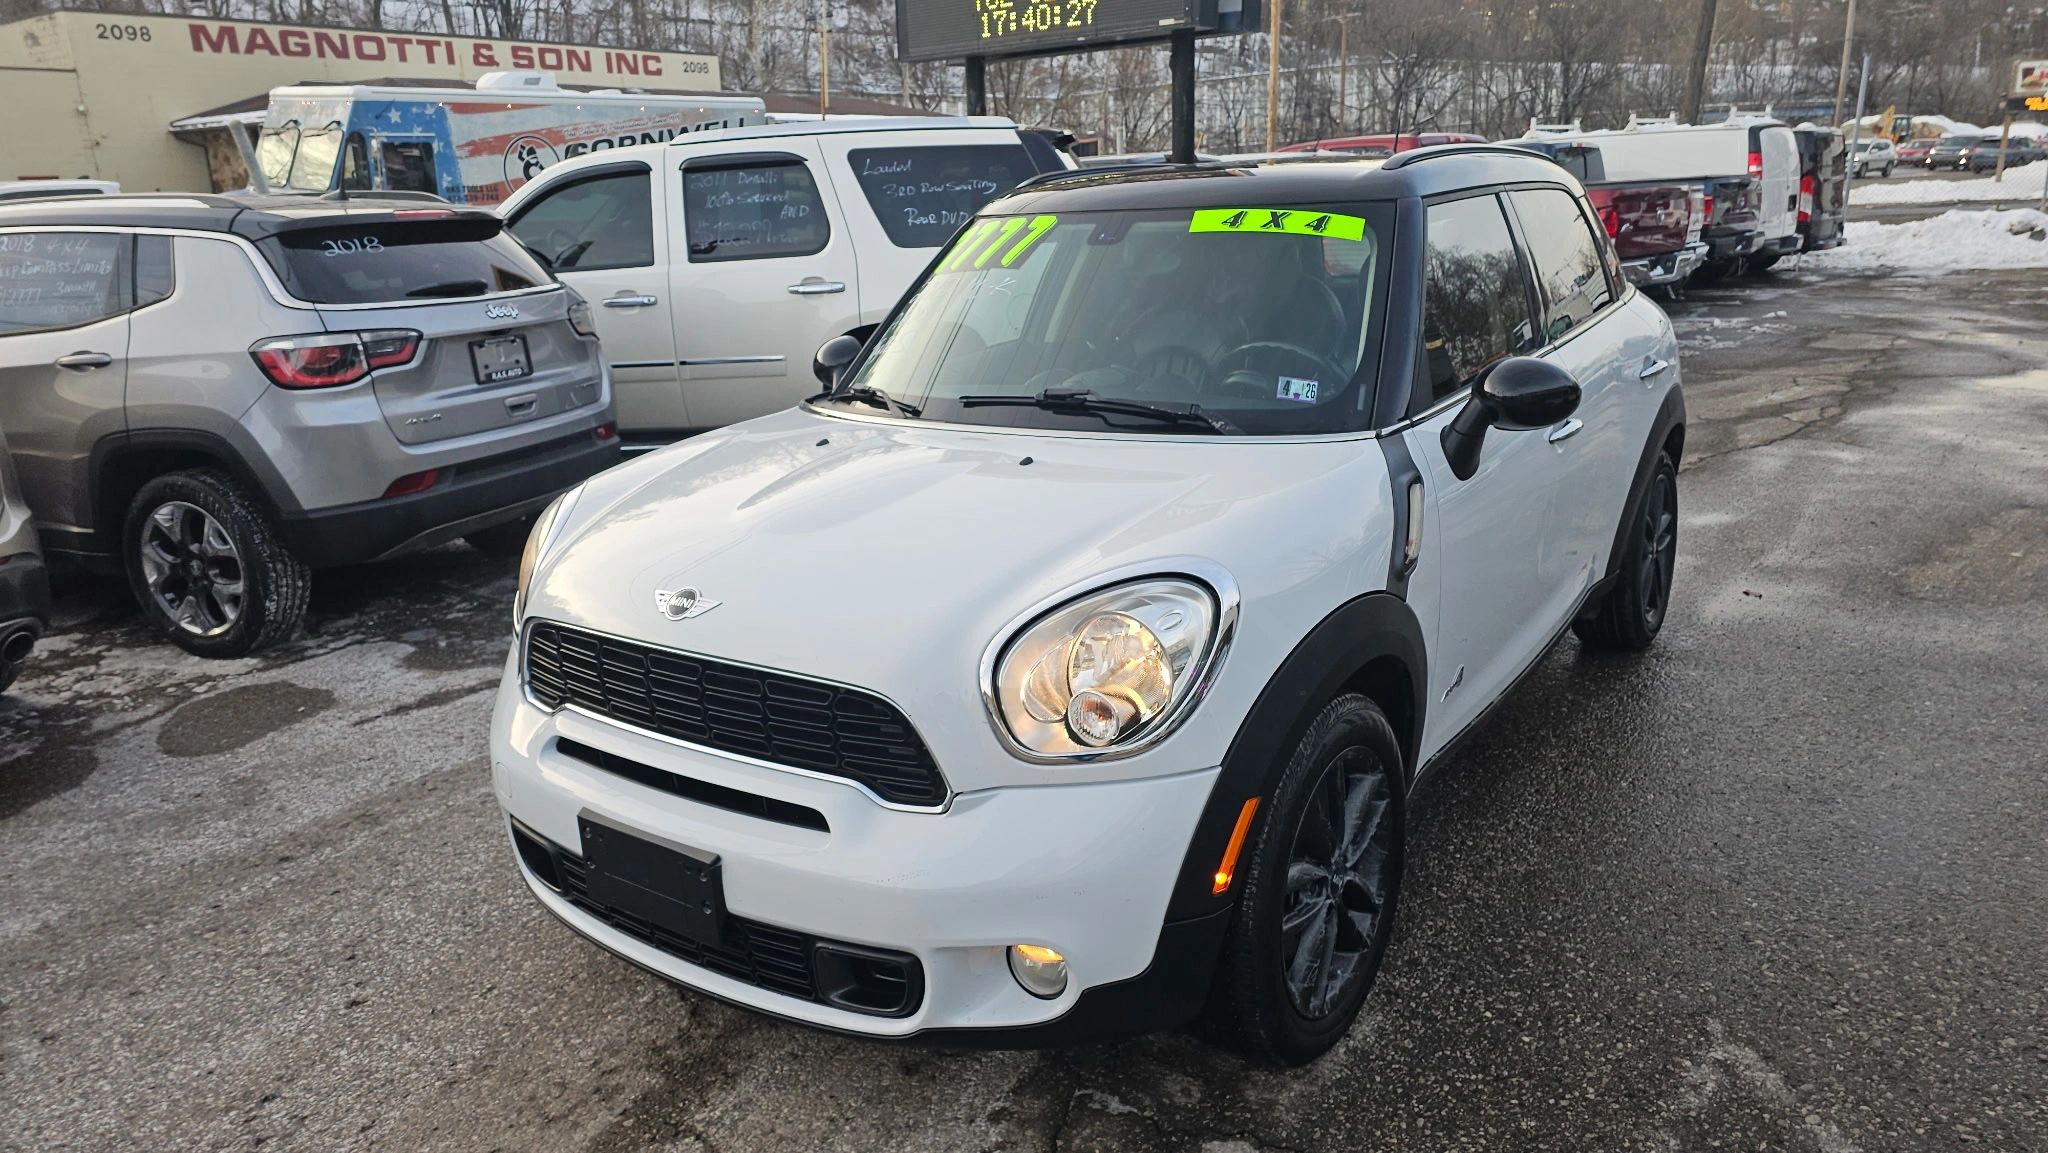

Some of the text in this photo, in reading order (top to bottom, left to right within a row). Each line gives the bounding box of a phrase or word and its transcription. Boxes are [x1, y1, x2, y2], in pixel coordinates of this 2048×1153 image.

[981, 0, 1098, 38] 17:40:27
[95, 23, 152, 42] 2098
[188, 24, 663, 76] MAGNOTTI & SON INC
[683, 61, 710, 74] 2098
[863, 158, 912, 175] Loaded
[940, 210, 969, 225] DVD
[1221, 210, 1331, 233] 4 X 4
[0, 235, 35, 253] 2018
[321, 236, 384, 257] 2018
[486, 303, 519, 320] Jeep
[1305, 382, 1317, 399] 26
[669, 595, 695, 609] MINI
